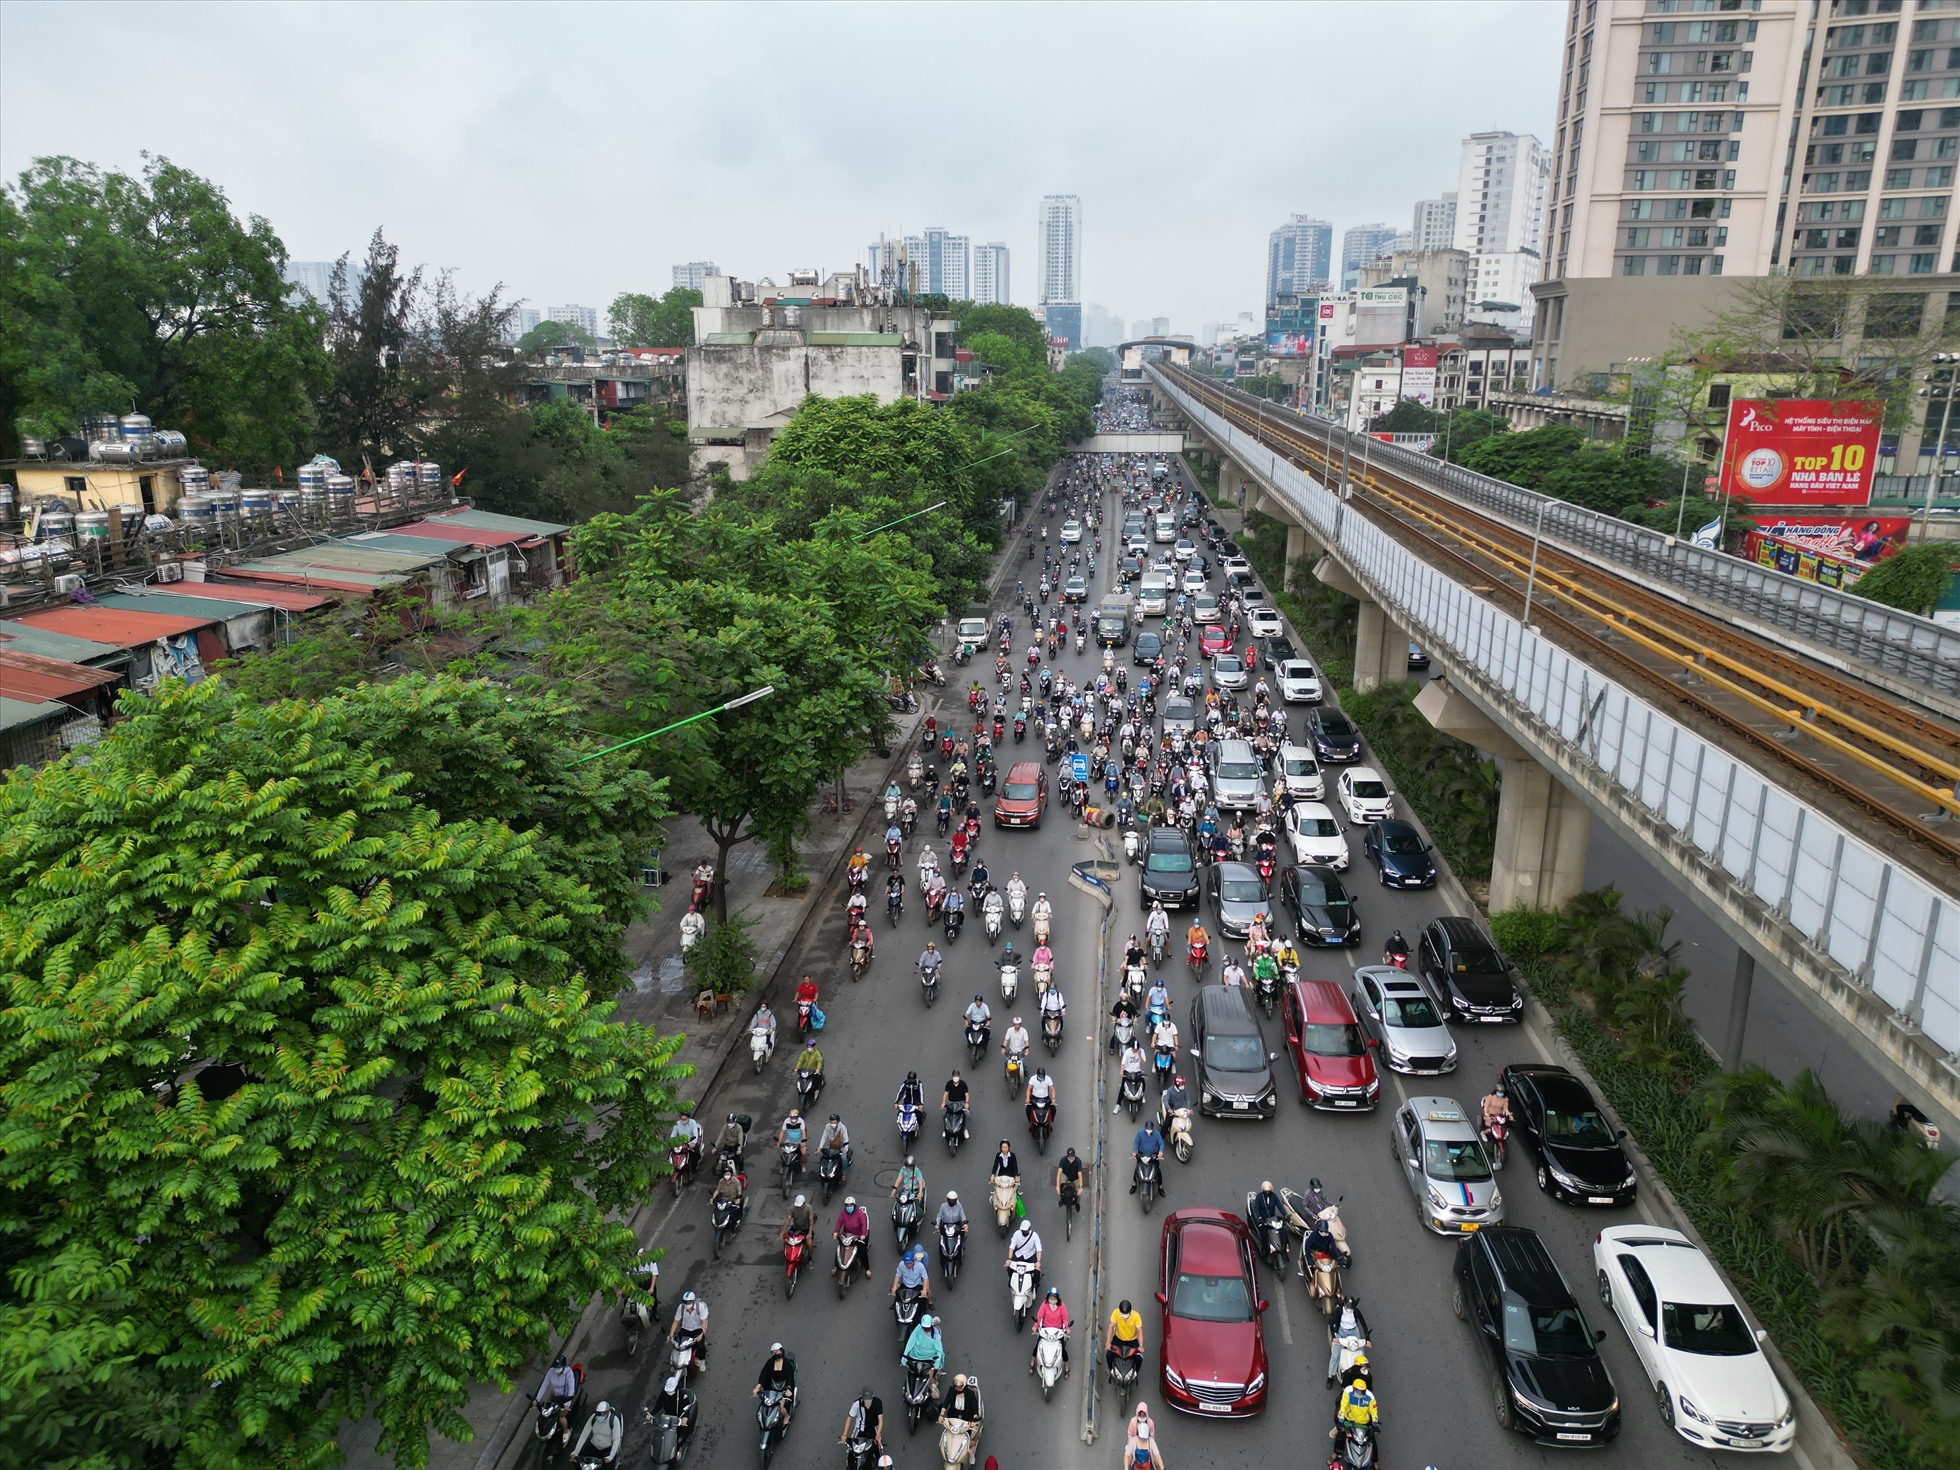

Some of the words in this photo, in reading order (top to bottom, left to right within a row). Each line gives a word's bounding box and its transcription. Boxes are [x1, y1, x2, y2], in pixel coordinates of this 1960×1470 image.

[1768, 458, 1775, 466] 10
[1794, 456, 1827, 470] TOP
[1830, 444, 1865, 471] 10
[1786, 525, 1812, 534] HÀNG
